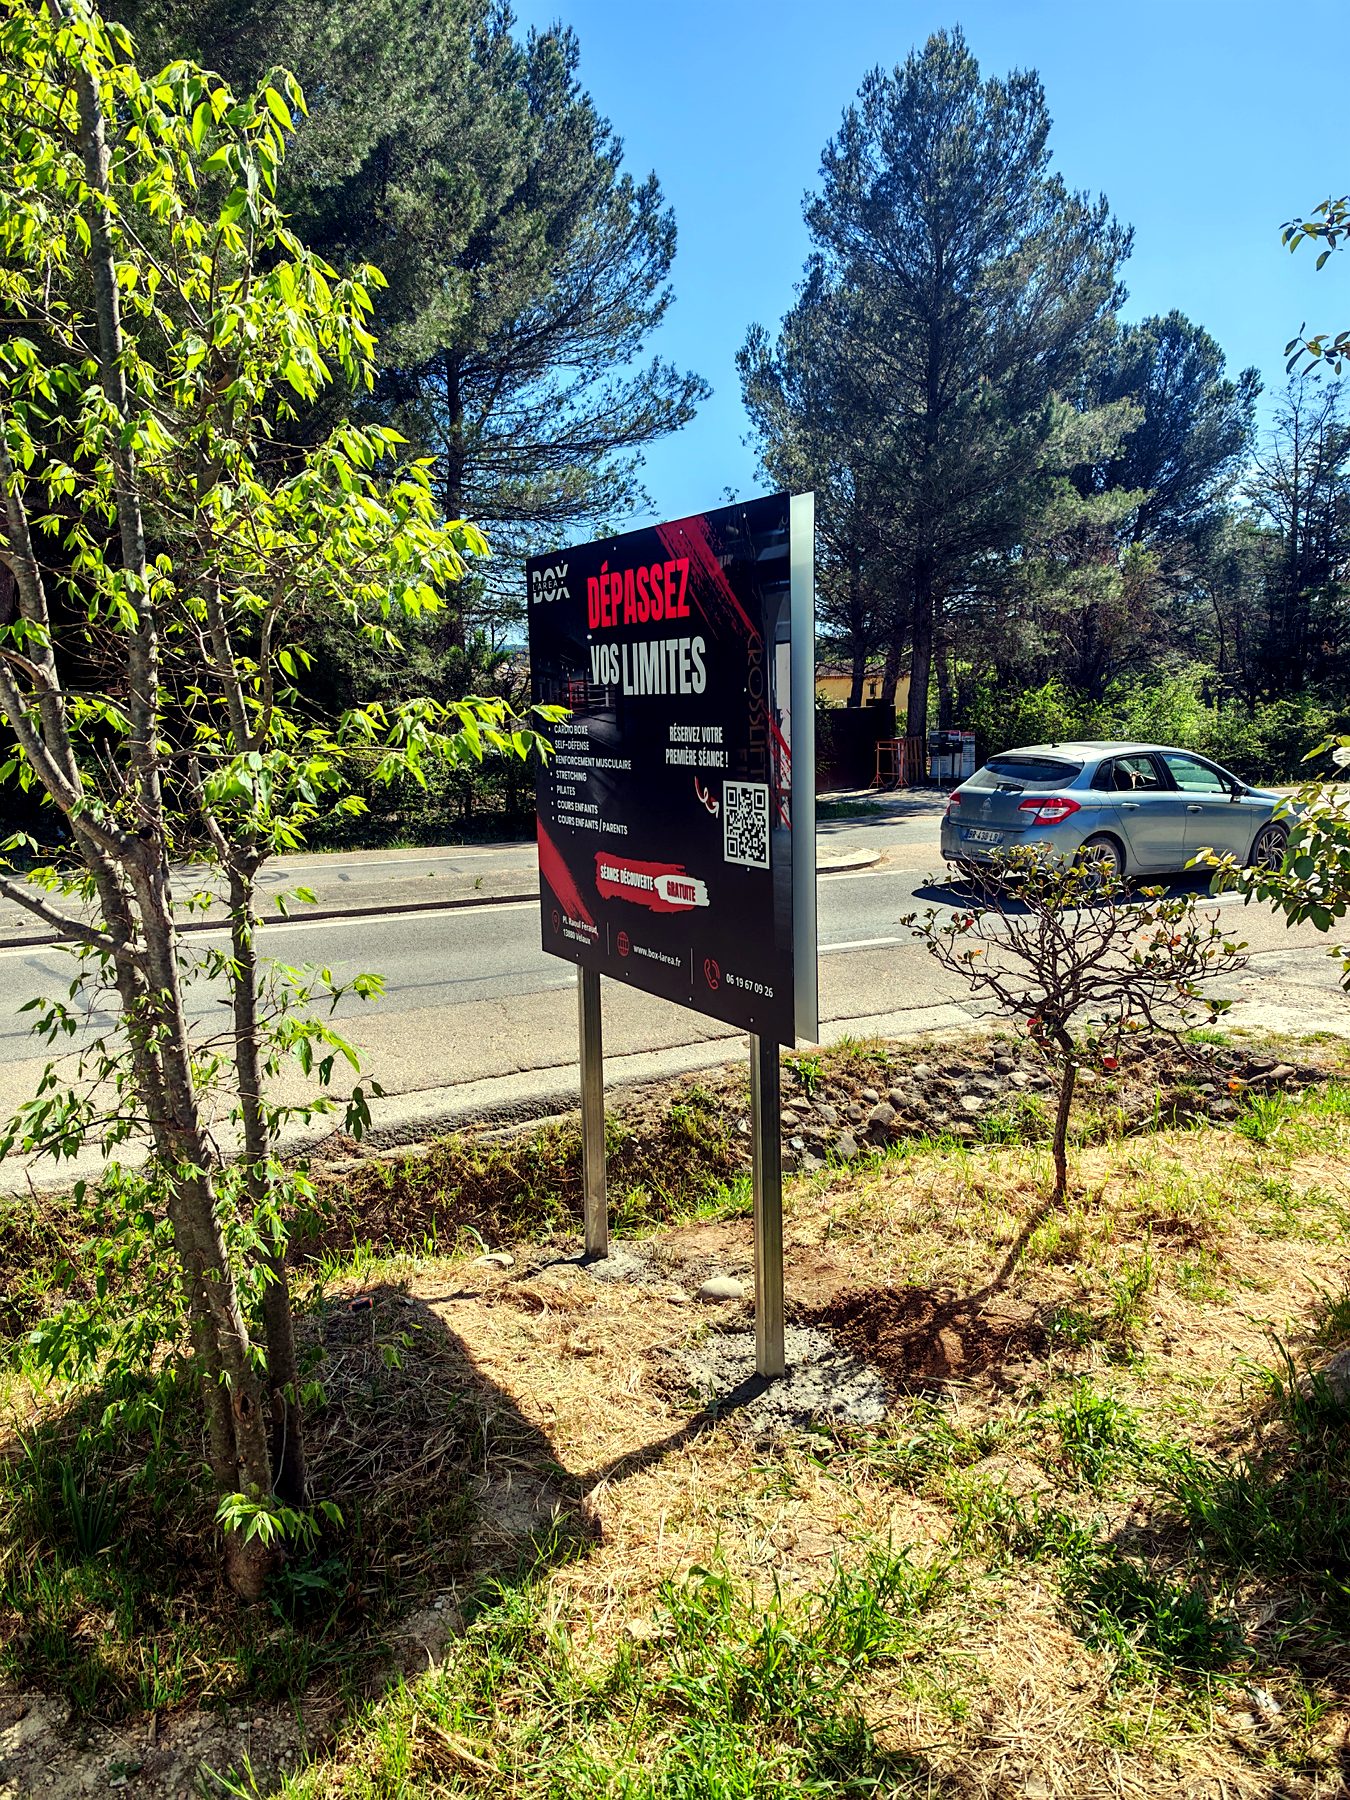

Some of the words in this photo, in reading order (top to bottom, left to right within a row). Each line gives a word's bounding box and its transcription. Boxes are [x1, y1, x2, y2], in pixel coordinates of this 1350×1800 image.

[587, 557, 690, 630] DÉPASSEZ
[590, 643, 620, 685] VOS
[621, 636, 706, 696] LIMITES
[553, 725, 574, 735] CARDIO
[574, 725, 589, 735] BOXE
[669, 722, 701, 743] RÉSERVEZ
[701, 726, 724, 744] VOTRE
[554, 738, 590, 751] SELF-DÉFENSE
[555, 755, 595, 768] RENFORCEMENT
[595, 758, 632, 770] MUSCULAIRE
[665, 745, 697, 766] PREMIÈRE
[698, 746, 724, 768] SÉANCE
[725, 751, 729, 768] !
[556, 770, 587, 782] STRETCHING
[556, 785, 576, 796] PILATES
[557, 800, 575, 811] COURS
[575, 802, 599, 815] ENFANTS
[557, 815, 575, 826] COURS
[575, 817, 599, 830] ENFANTS
[602, 822, 628, 835] PARENTS
[600, 863, 620, 883] SÉANCE
[620, 867, 654, 891] DÉCOUVERTE
[666, 880, 697, 903] GRATUITE
[568, 917, 581, 929] Raoul
[576, 932, 591, 945] Velaux
[633, 944, 682, 967] www.box-larea.fr
[726, 973, 735, 985] 06
[735, 976, 744, 988] 19
[744, 979, 753, 991] 67
[754, 983, 764, 994] 09
[764, 986, 774, 998] 26
